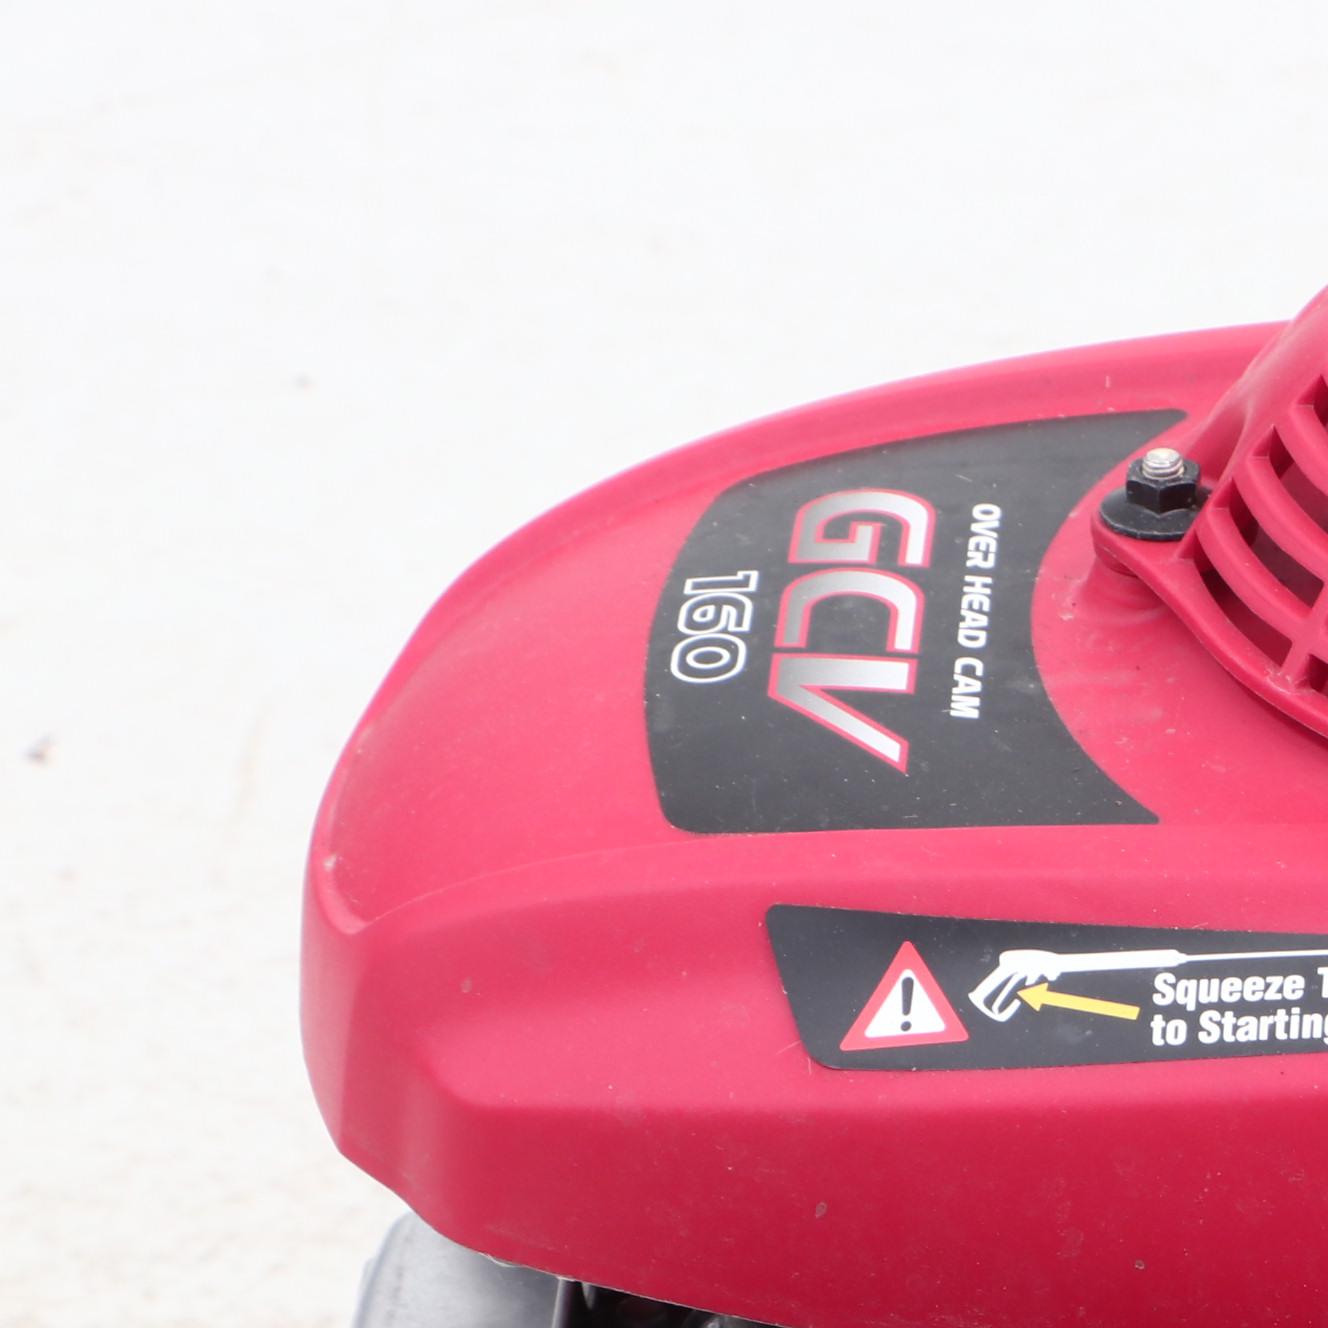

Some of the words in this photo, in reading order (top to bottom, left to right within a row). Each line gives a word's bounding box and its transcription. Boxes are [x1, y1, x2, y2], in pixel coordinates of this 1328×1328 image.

[967, 503, 1002, 569] OVER
[671, 571, 758, 684] 160
[768, 488, 936, 773] GCV
[959, 576, 992, 648] HEAD
[951, 657, 984, 719] CAM
[1153, 969, 1305, 1011] Squeeze
[1151, 1009, 1187, 1045] to
